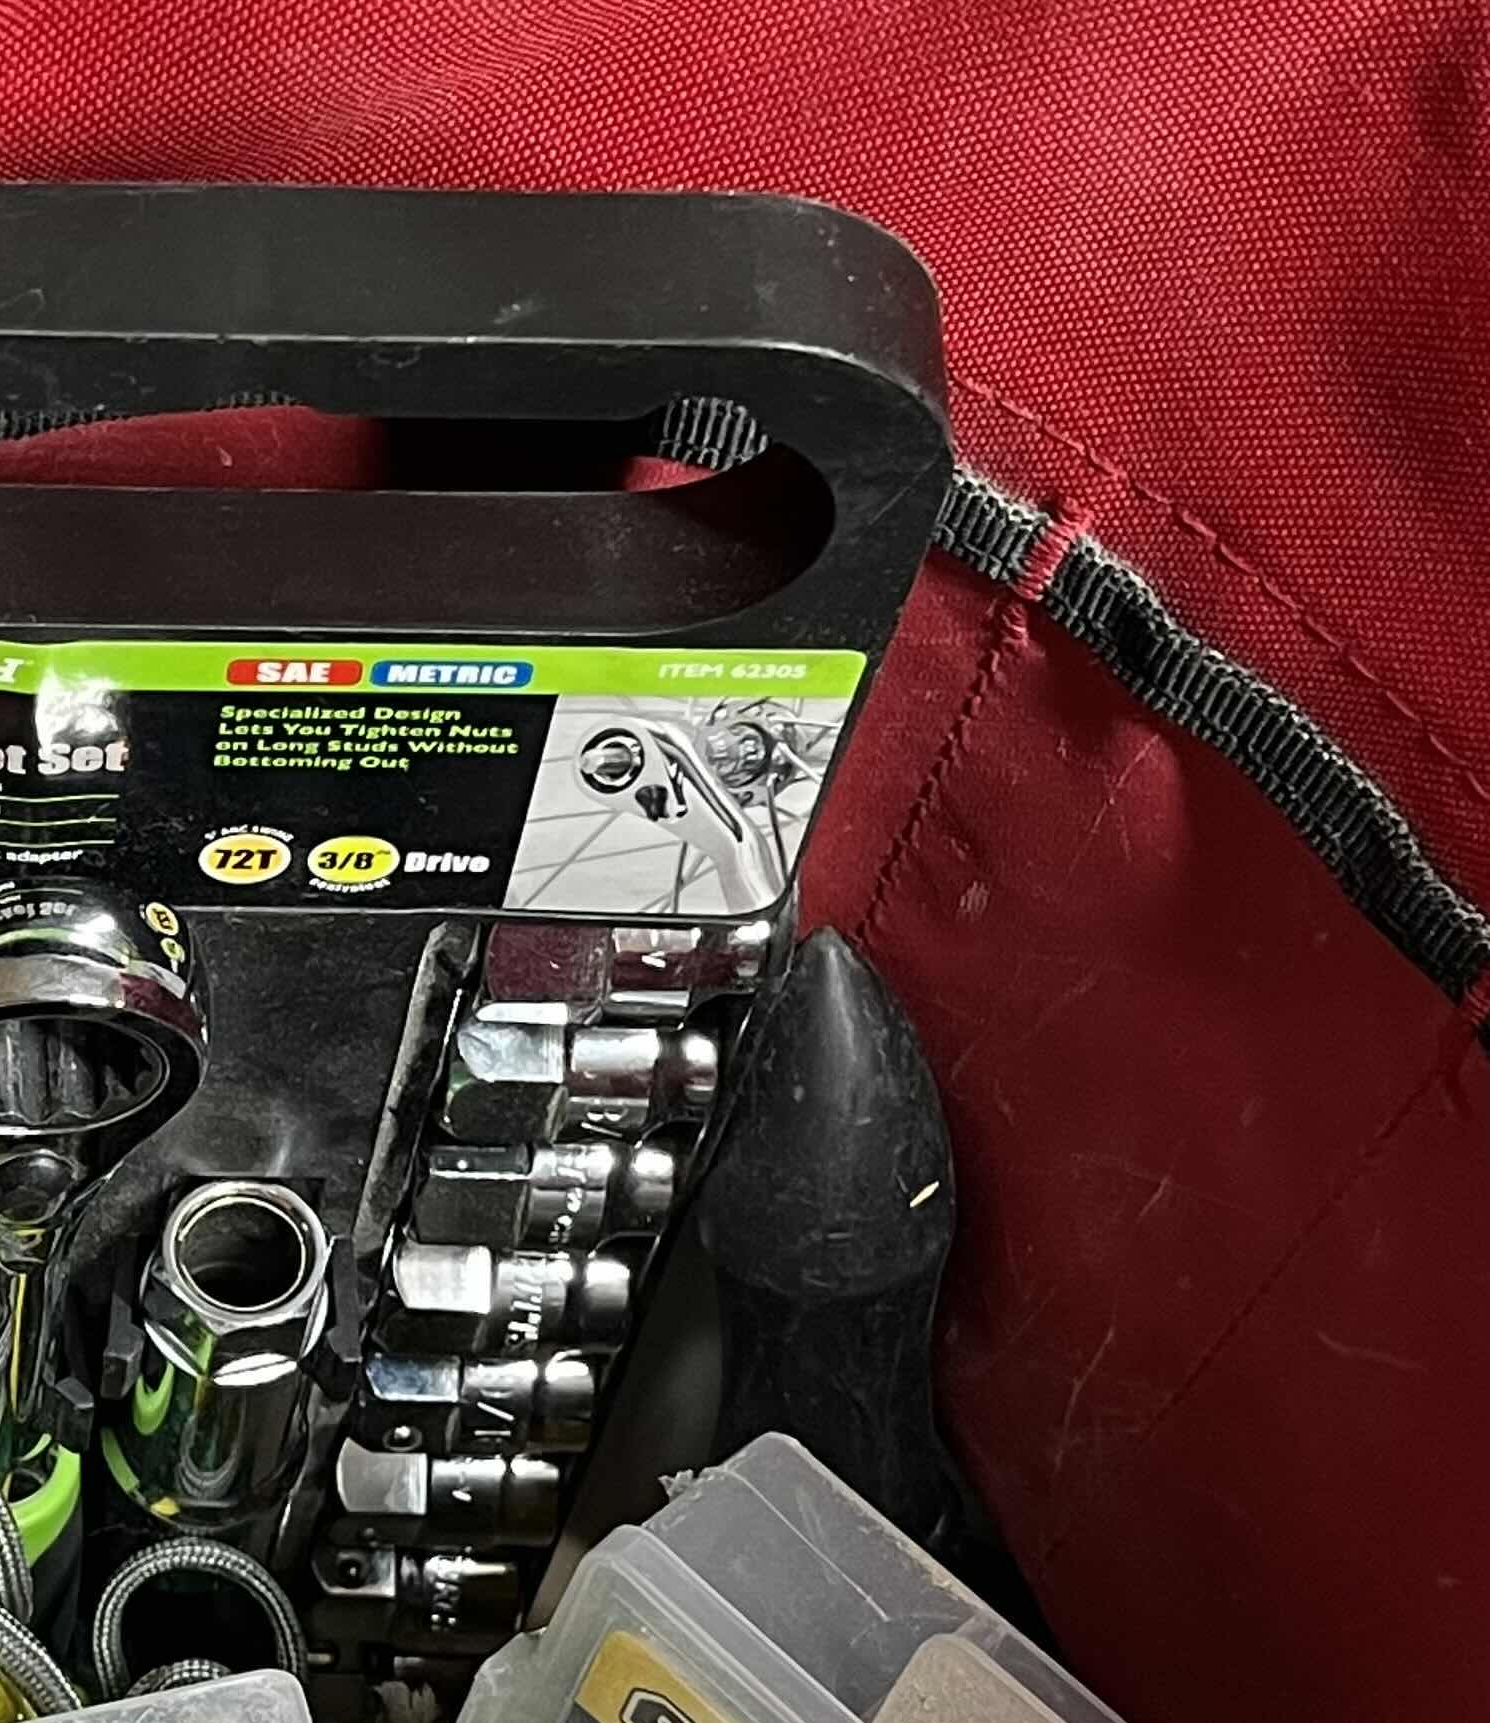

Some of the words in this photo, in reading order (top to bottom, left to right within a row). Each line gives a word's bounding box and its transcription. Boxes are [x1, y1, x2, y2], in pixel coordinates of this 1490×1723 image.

[256, 661, 332, 683] SAE
[387, 664, 518, 685] METRIC
[658, 663, 723, 679] ITEM
[730, 663, 808, 680] 62305
[220, 705, 366, 722] Specialized
[373, 707, 462, 724] Design
[218, 723, 274, 736] Lets
[282, 723, 331, 736] You
[339, 723, 441, 739] Tighten
[448, 724, 513, 738] Nuts
[215, 740, 249, 751] on
[257, 738, 319, 755] Long
[326, 740, 399, 753] Studs
[408, 740, 519, 754] Without
[37, 738, 129, 776] Set
[213, 754, 353, 771] Bottoming
[360, 756, 411, 770] Out
[6, 849, 84, 865] adapter
[214, 848, 278, 870] 72T
[404, 851, 491, 873] Drive
